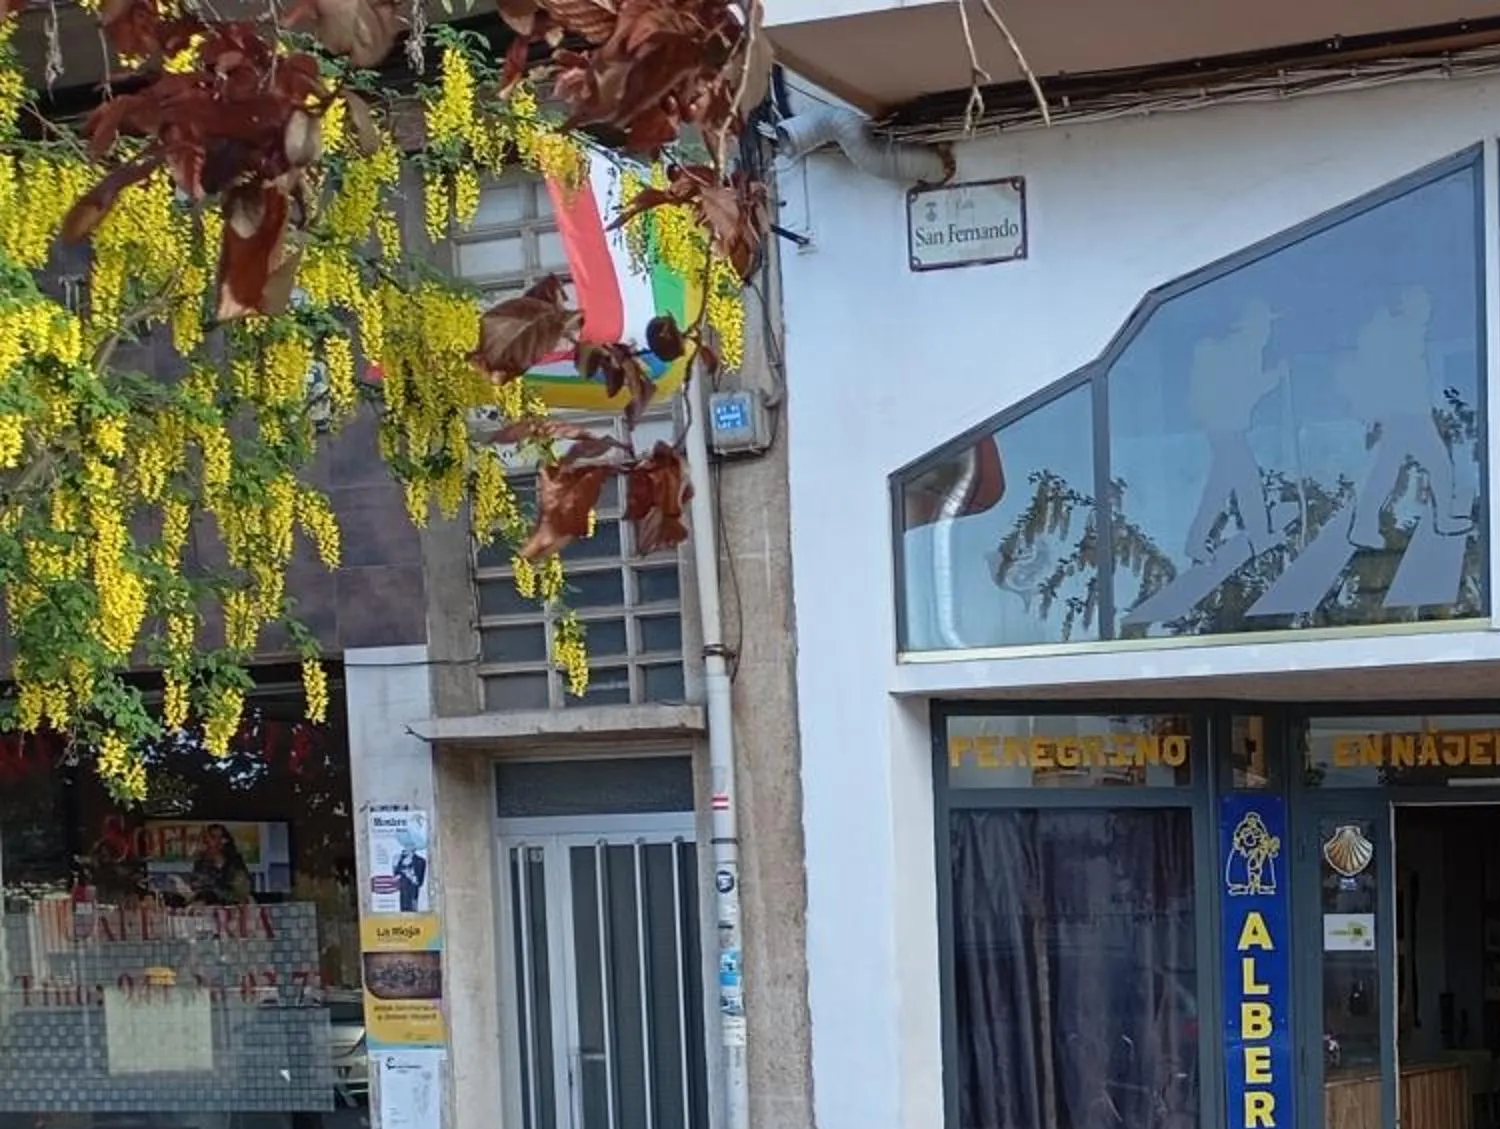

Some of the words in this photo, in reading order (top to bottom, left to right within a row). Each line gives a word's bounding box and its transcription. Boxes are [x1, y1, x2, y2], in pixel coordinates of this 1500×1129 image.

[915, 226, 945, 247] San
[948, 218, 1019, 243] Fernando
[951, 734, 1190, 769] PEREGRINO
[1333, 733, 1384, 768] EN
[64, 894, 276, 941] CAFERIA
